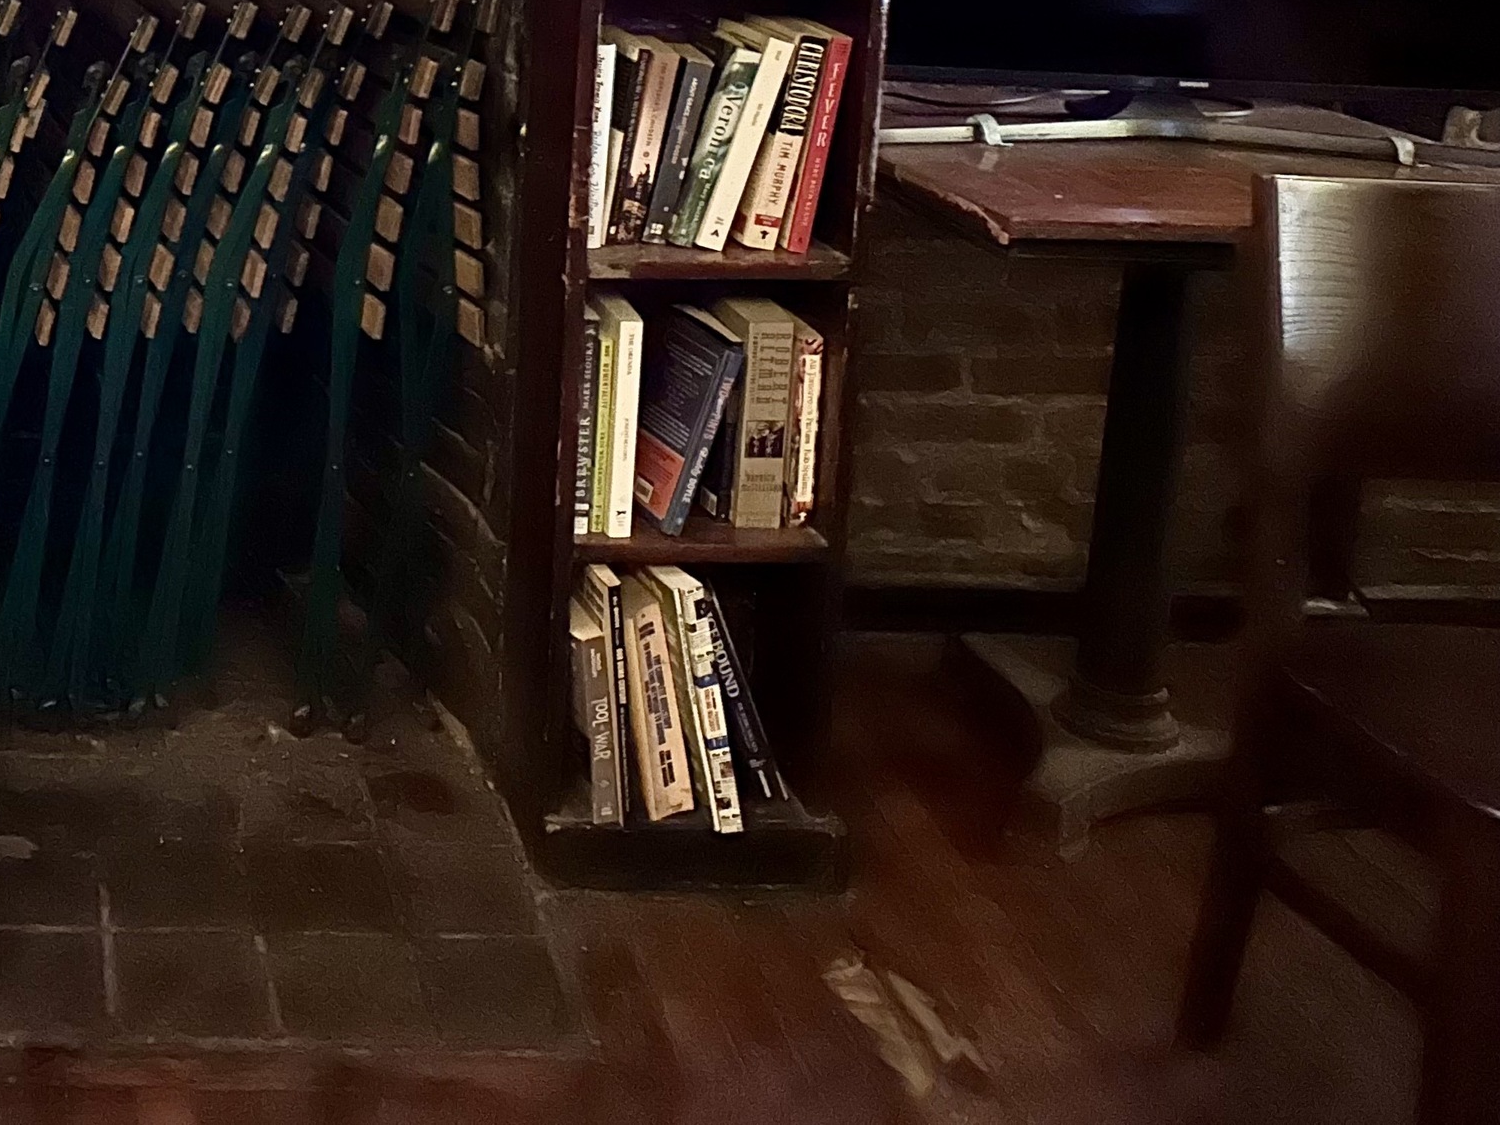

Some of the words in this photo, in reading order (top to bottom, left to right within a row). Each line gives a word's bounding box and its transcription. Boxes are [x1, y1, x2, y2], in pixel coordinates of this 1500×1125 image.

[780, 41, 824, 133] CHRISTODORA
[815, 61, 842, 147] FEVER
[697, 91, 743, 182] Veronica
[778, 140, 793, 159] TIM
[767, 163, 787, 205] MURPHY
[584, 341, 593, 378] SLOUKA
[755, 332, 776, 405] ALTMAN
[770, 332, 792, 404] ROBERT
[582, 381, 590, 408] MARK
[718, 375, 734, 398] TWO
[702, 412, 721, 441] PINTS
[574, 415, 591, 497] BREWSTER
[681, 476, 697, 503] DOYLE
[709, 640, 741, 699] BOUND
[590, 696, 608, 726] TOOL
[592, 731, 611, 760] WAR
